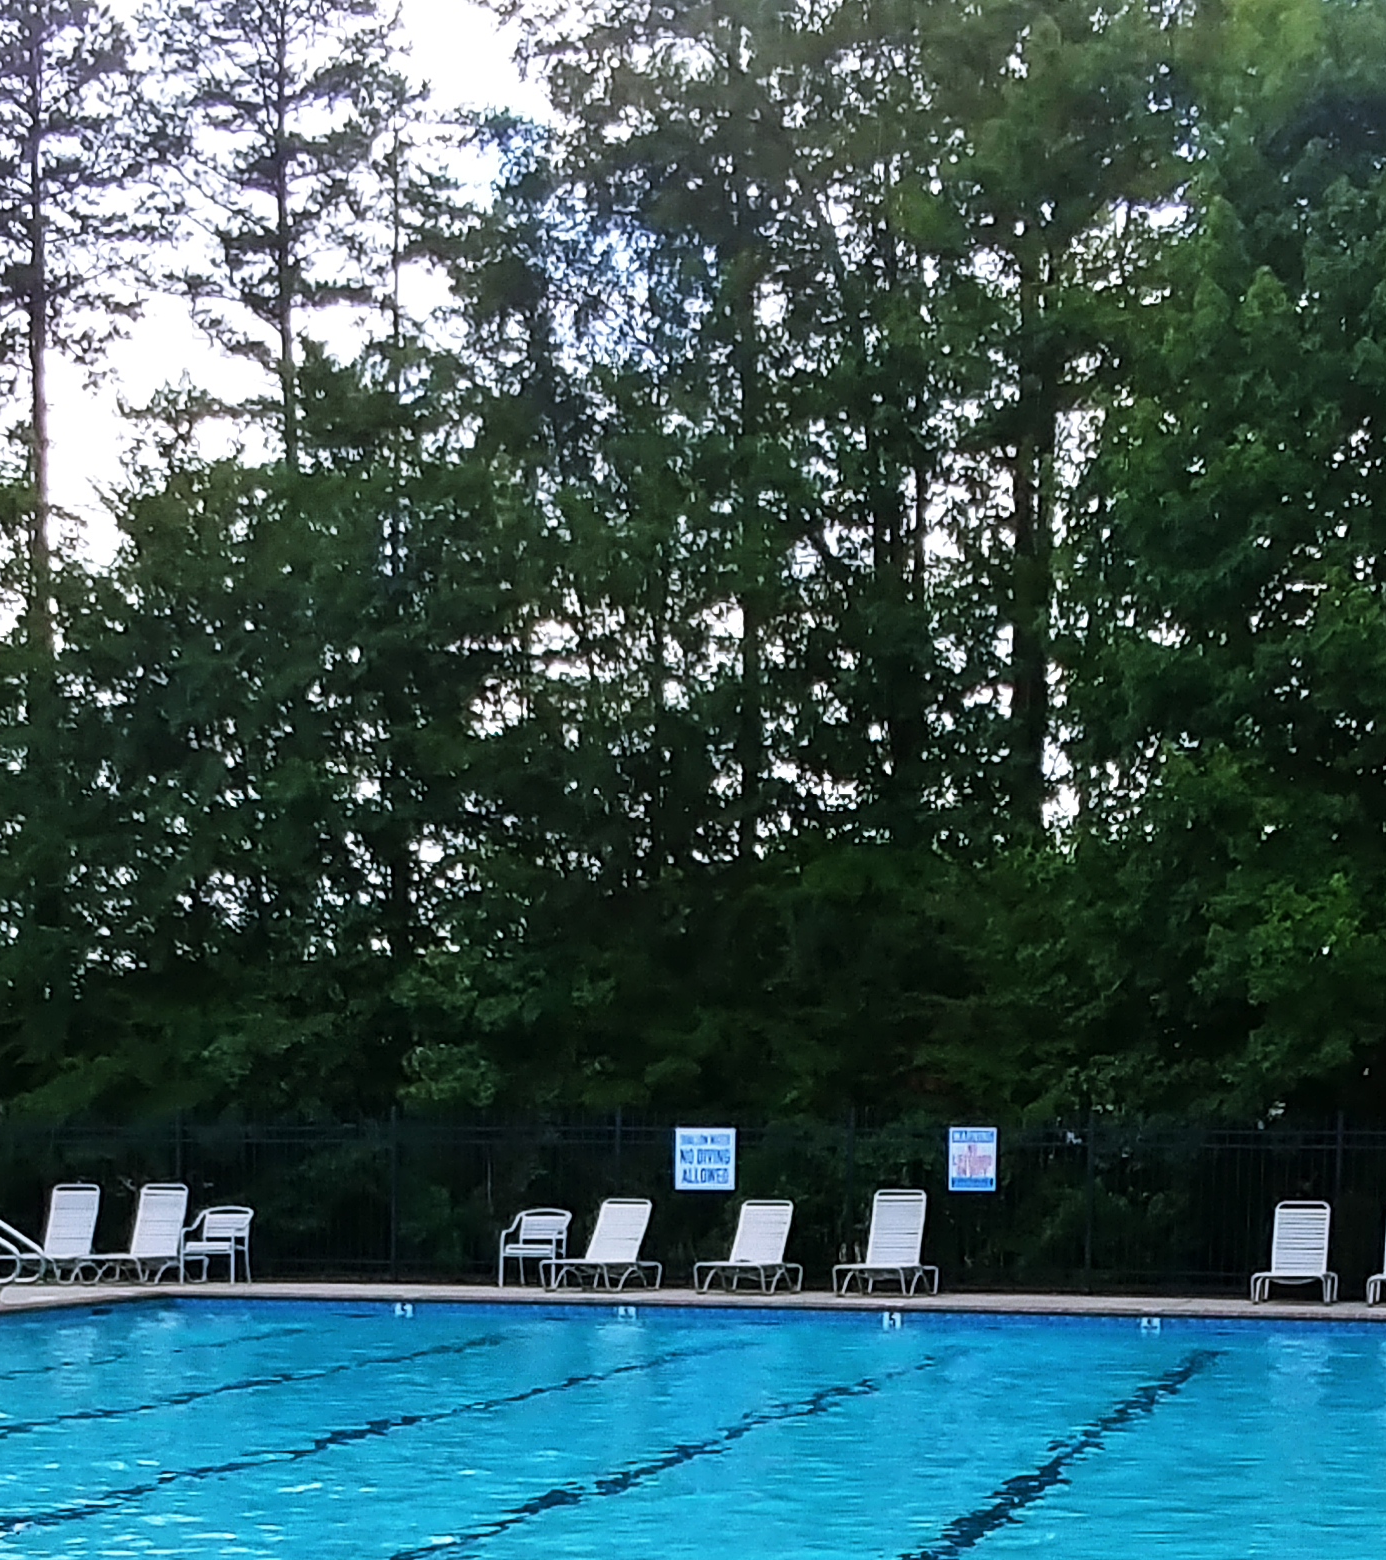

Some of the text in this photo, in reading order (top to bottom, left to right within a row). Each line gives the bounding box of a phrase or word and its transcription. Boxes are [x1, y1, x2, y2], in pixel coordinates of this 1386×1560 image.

[680, 1149, 730, 1165] NO DIVING
[682, 1168, 729, 1184] ALLOWED
